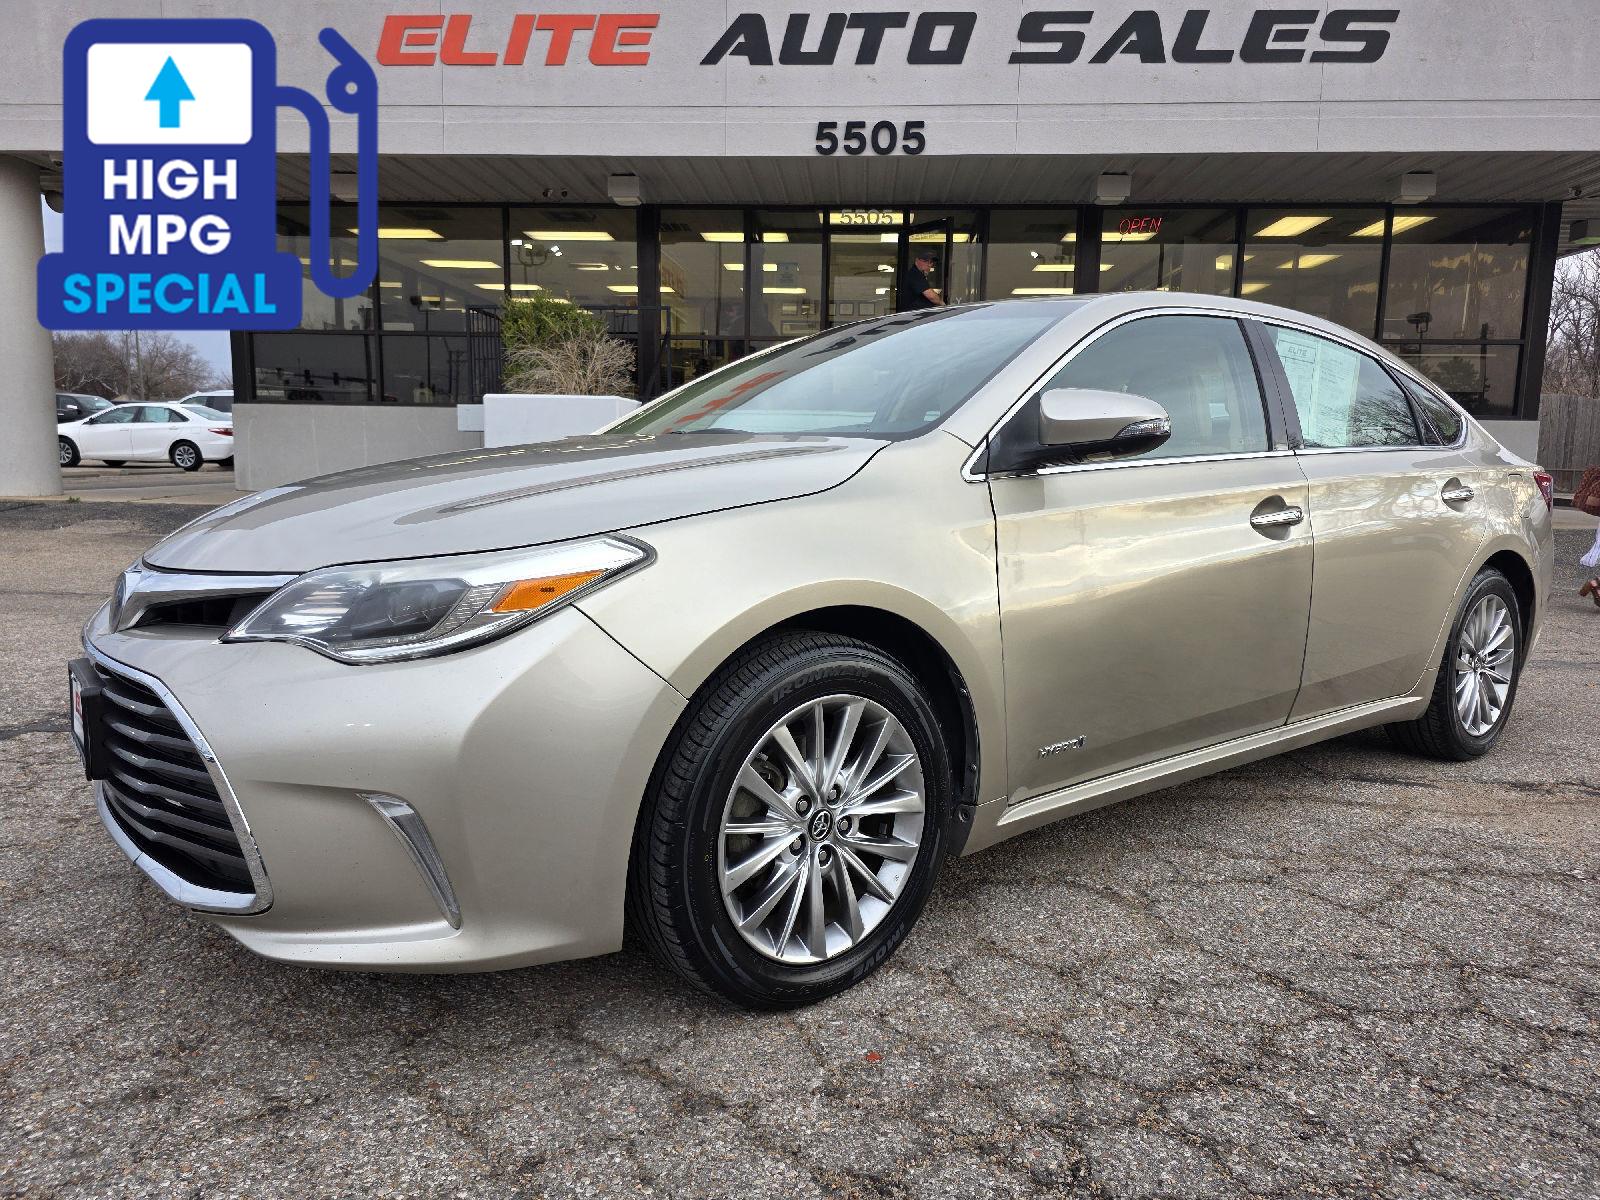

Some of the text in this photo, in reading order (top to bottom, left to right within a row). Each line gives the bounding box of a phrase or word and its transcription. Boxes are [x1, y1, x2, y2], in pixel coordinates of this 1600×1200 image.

[376, 9, 1400, 66] ELITE AUTO SALES
[815, 121, 927, 156] 5505
[840, 209, 893, 225] 5505
[1119, 216, 1163, 235] OPEN
[1288, 346, 1308, 357] ELITE
